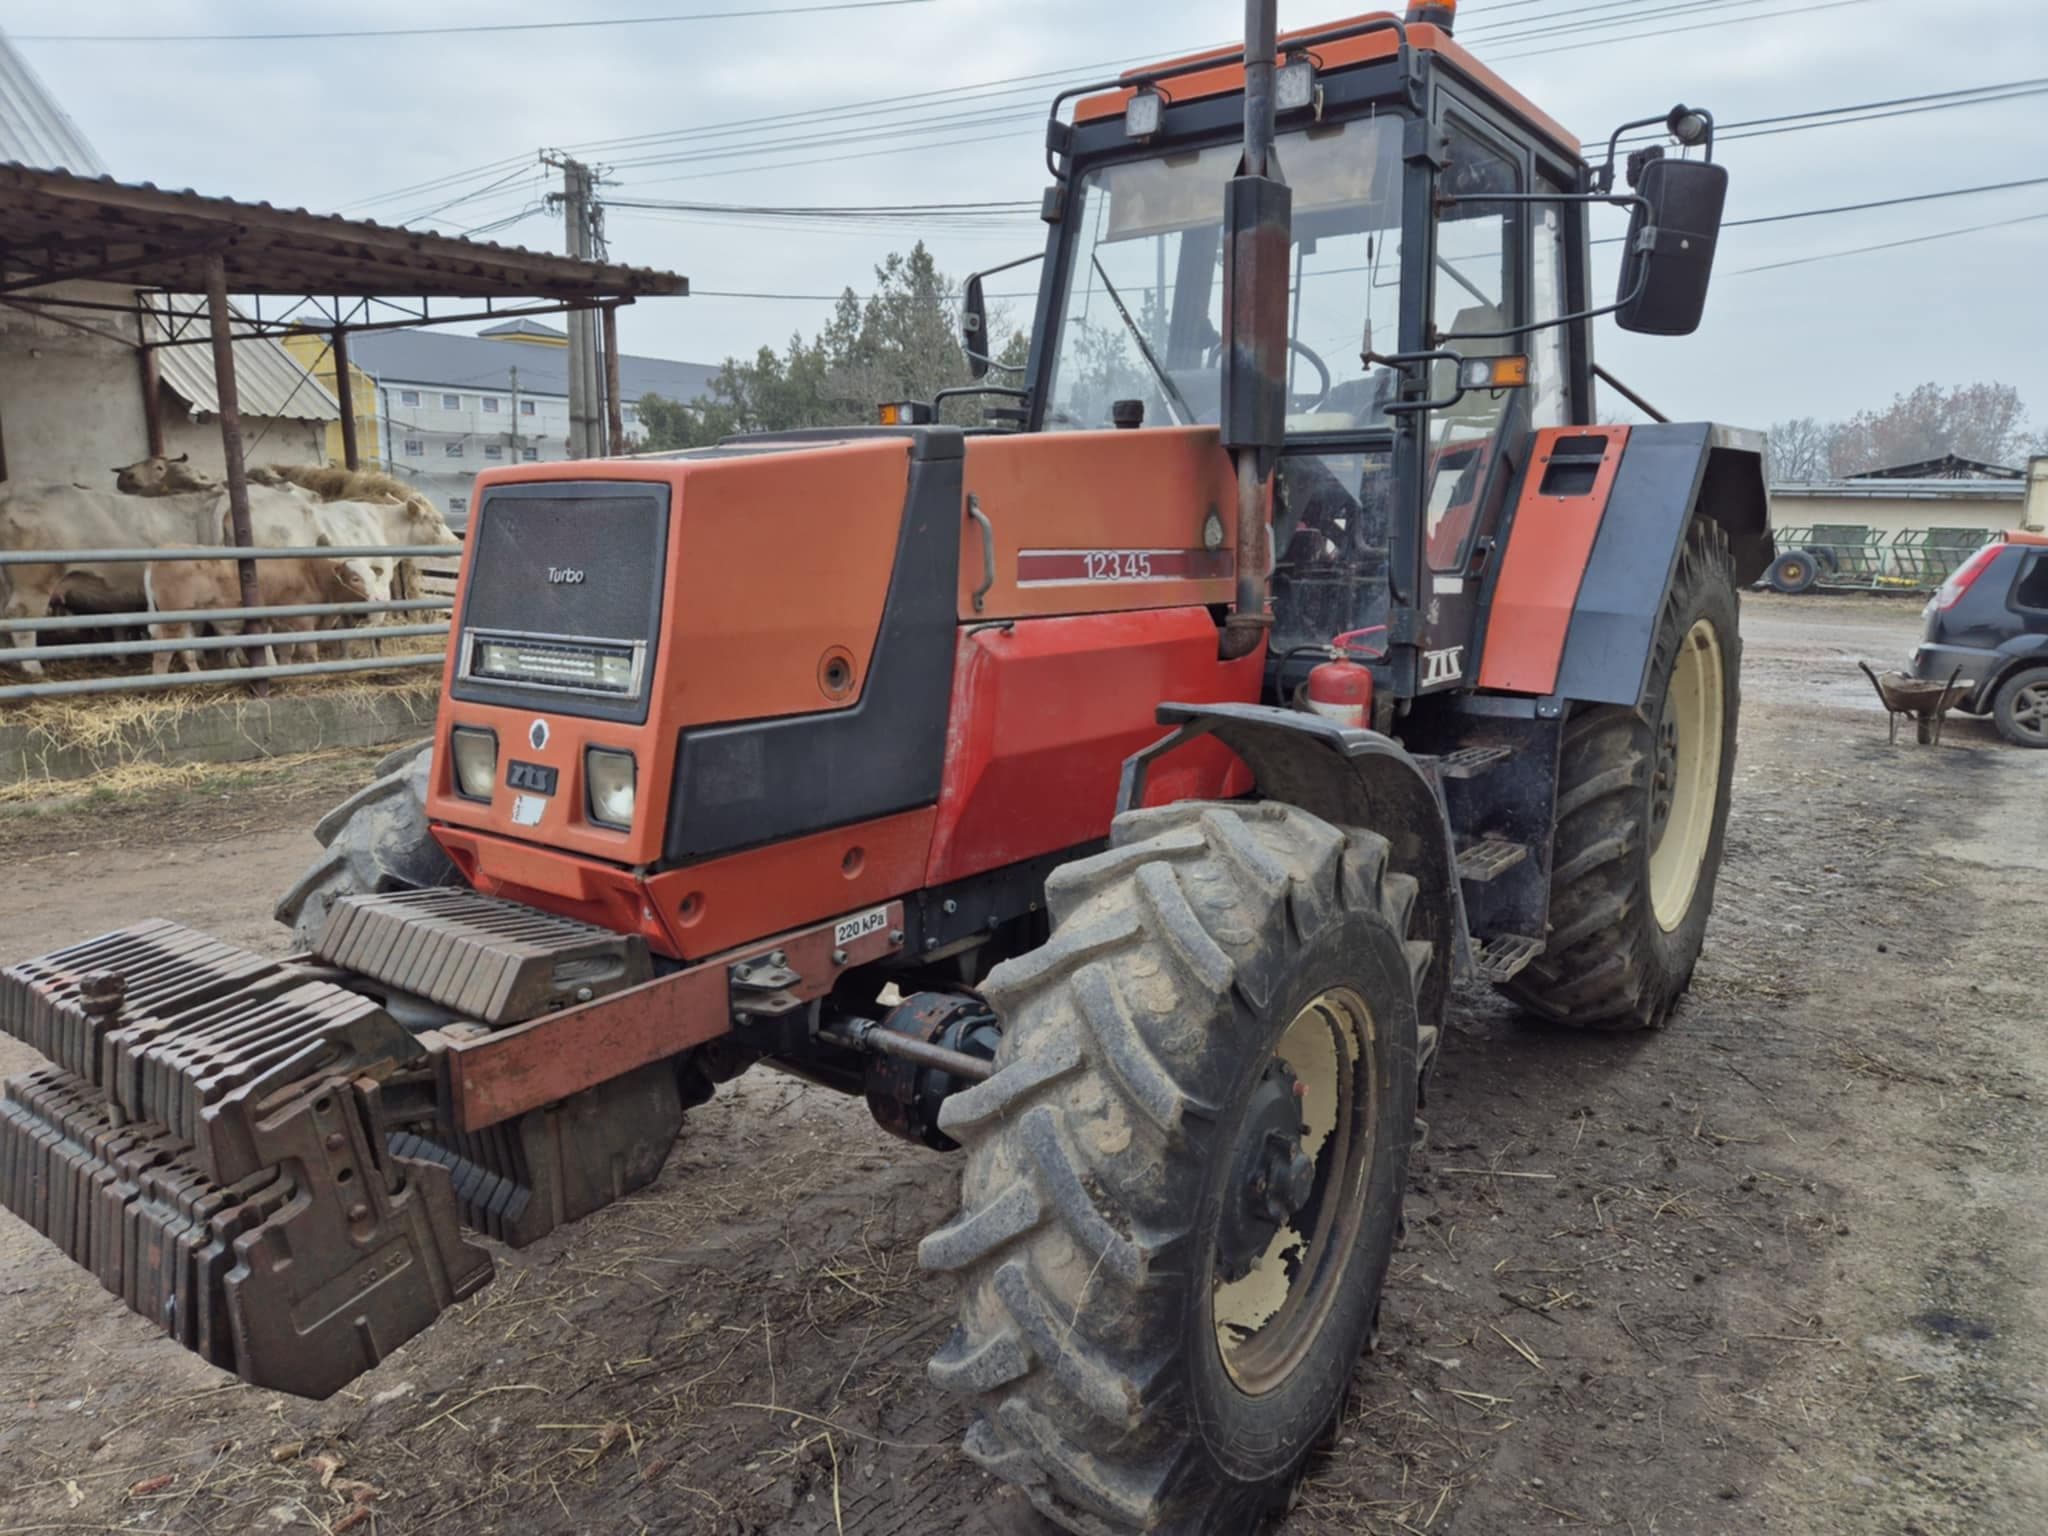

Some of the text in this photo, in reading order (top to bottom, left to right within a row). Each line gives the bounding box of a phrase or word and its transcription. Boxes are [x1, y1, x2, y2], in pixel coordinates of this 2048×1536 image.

[548, 567, 585, 584] Turbo
[838, 911, 885, 942] 220 kPa
